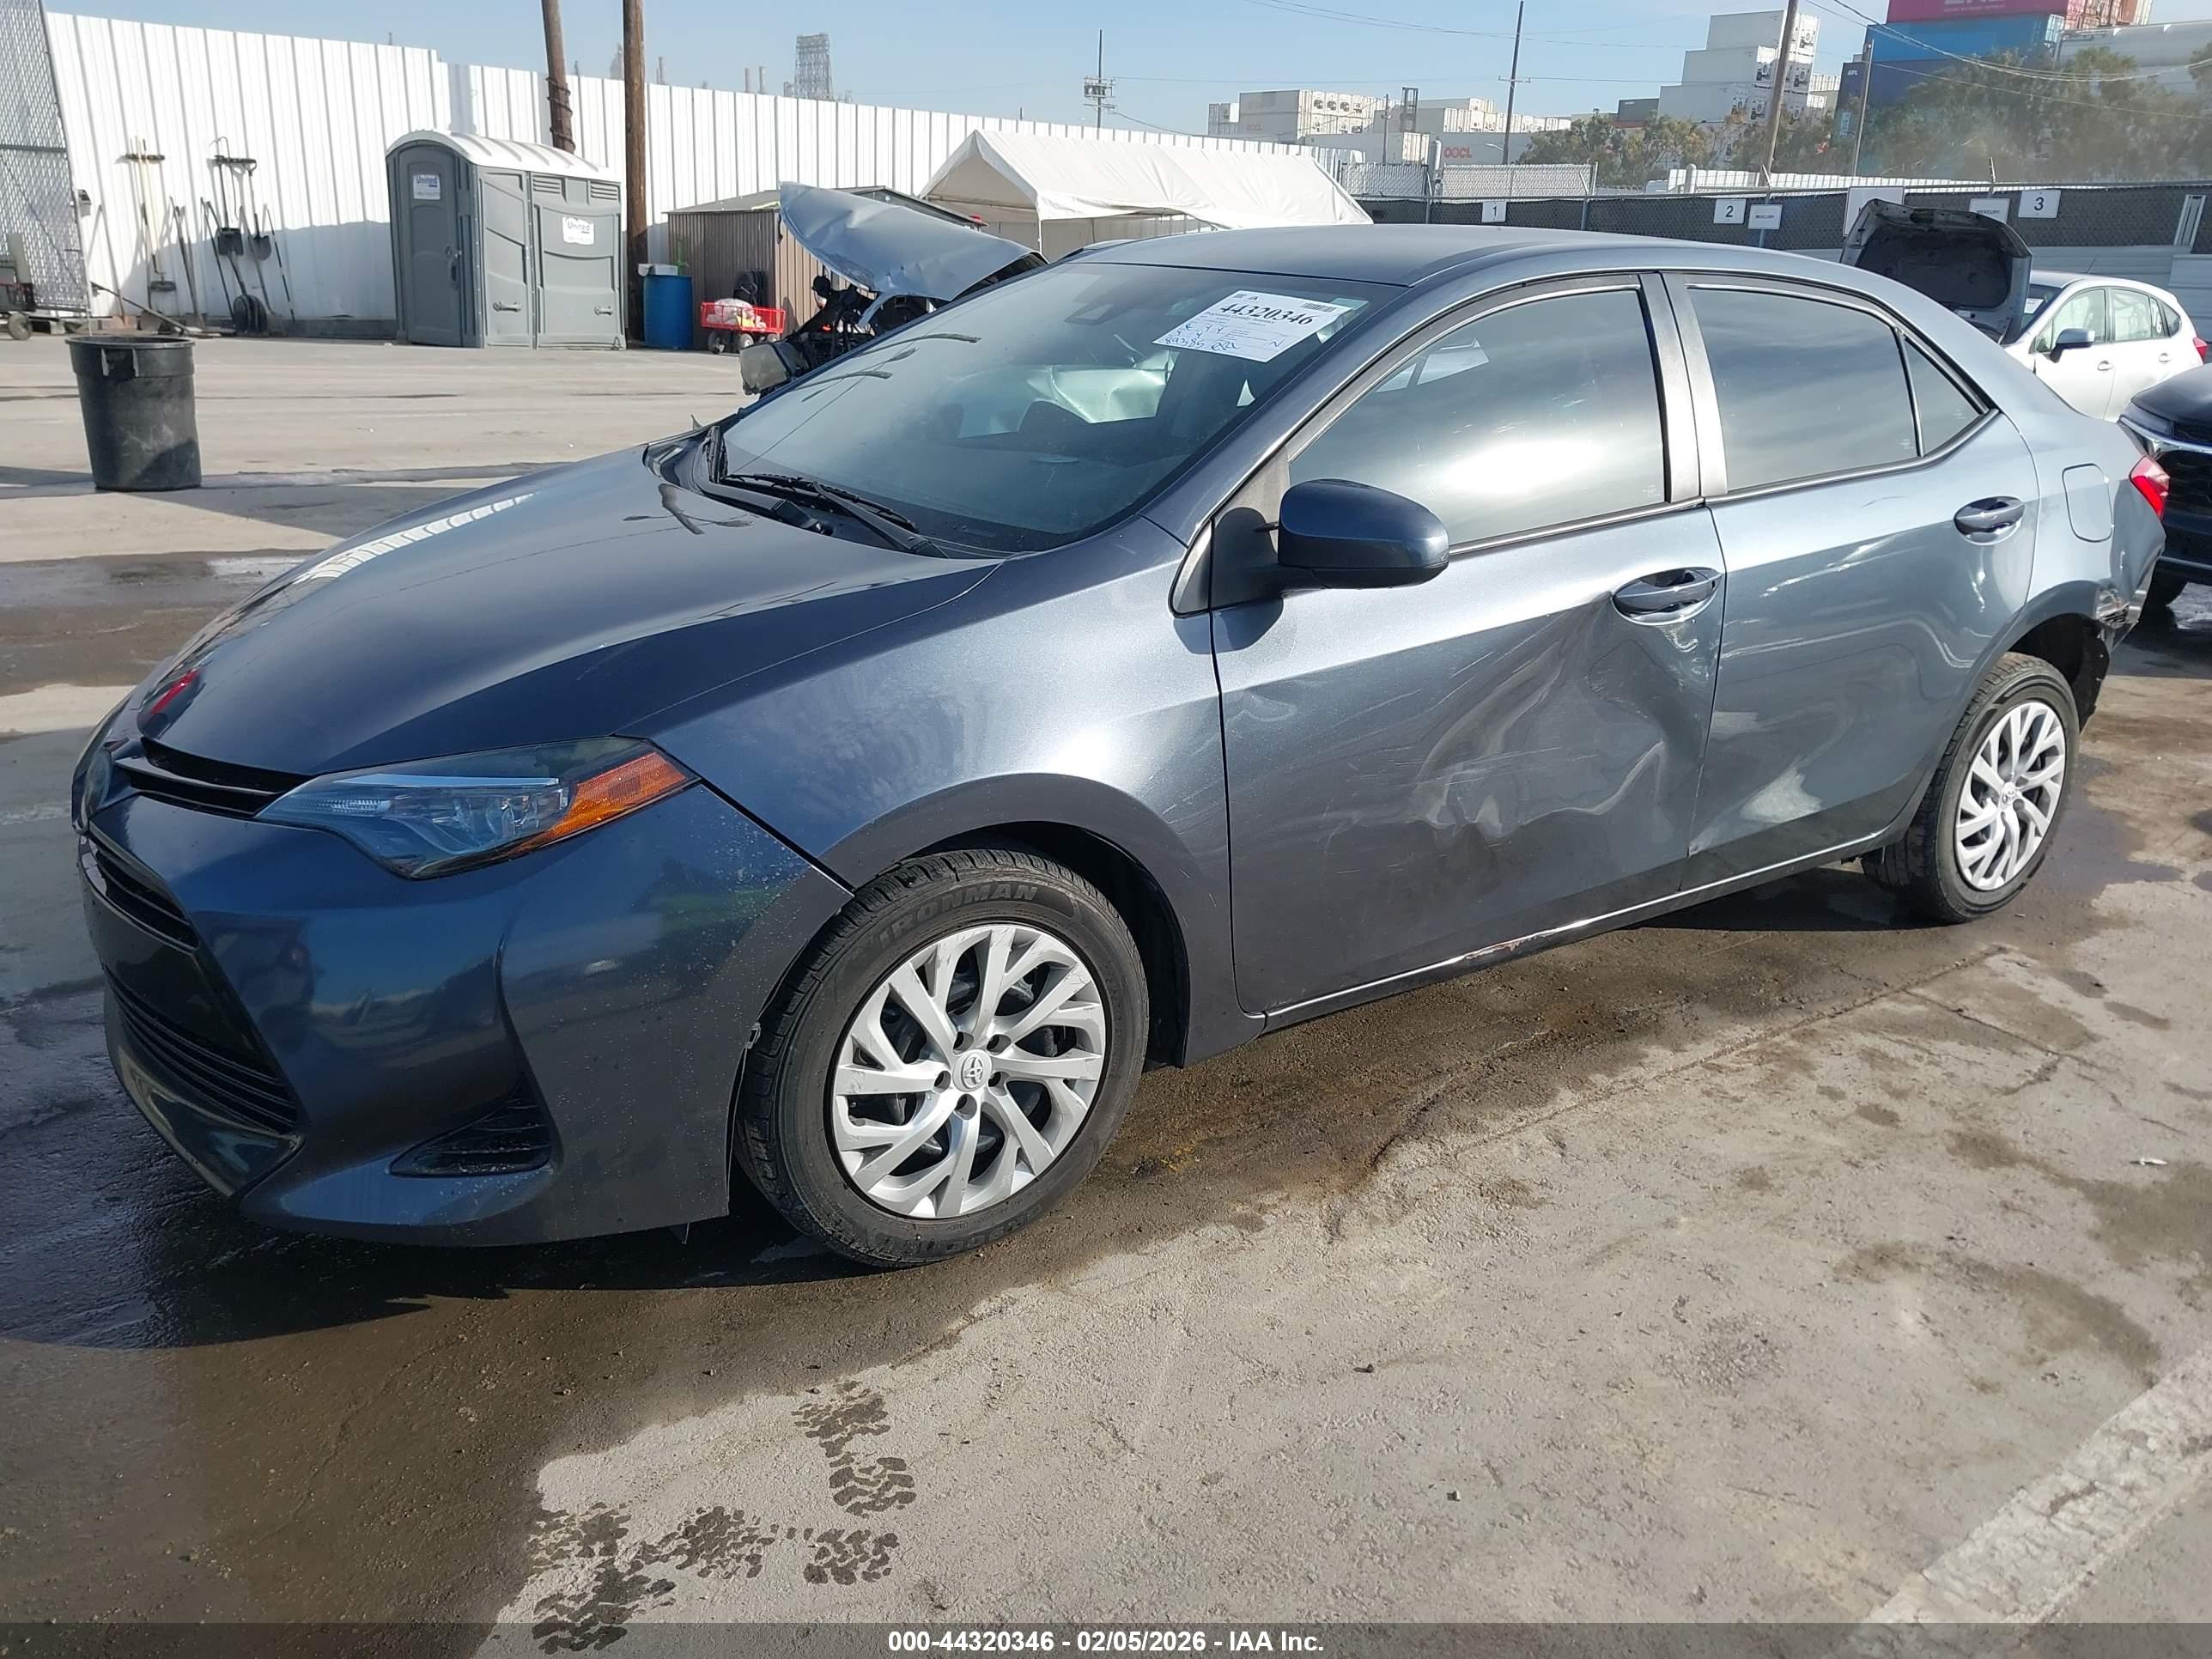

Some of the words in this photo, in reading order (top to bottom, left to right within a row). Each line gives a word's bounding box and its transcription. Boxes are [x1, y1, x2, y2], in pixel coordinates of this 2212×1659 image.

[1443, 147, 1472, 158] OOCL
[1492, 205, 1498, 216] 1
[2034, 197, 2045, 211] 3
[1725, 205, 1734, 217] 2
[1220, 303, 1316, 325] 44320346
[878, 884, 1038, 949] IRONMAN
